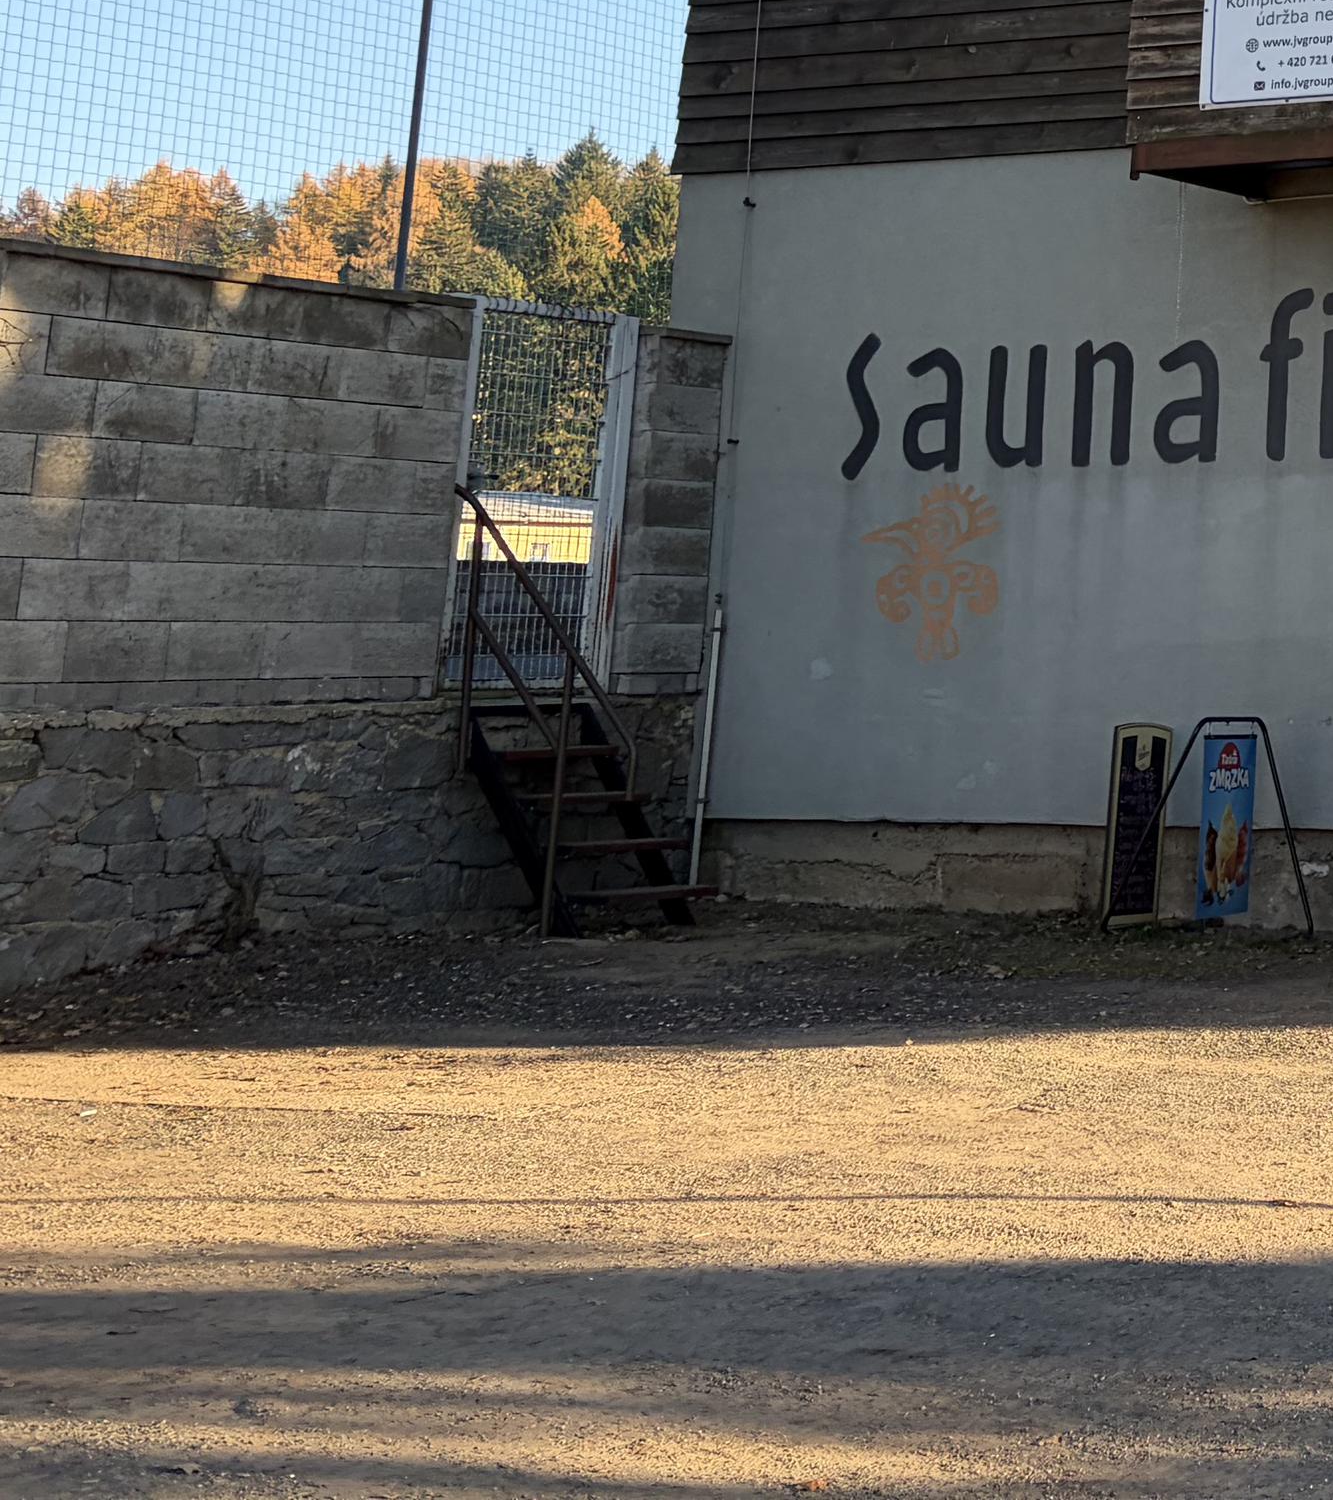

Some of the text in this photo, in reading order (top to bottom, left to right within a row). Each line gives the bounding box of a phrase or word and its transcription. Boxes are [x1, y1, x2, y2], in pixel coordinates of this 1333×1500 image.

[1256, 10, 1309, 26] údržba
[1310, 55, 1328, 66] 721
[1208, 767, 1250, 792] ZMRZKA
